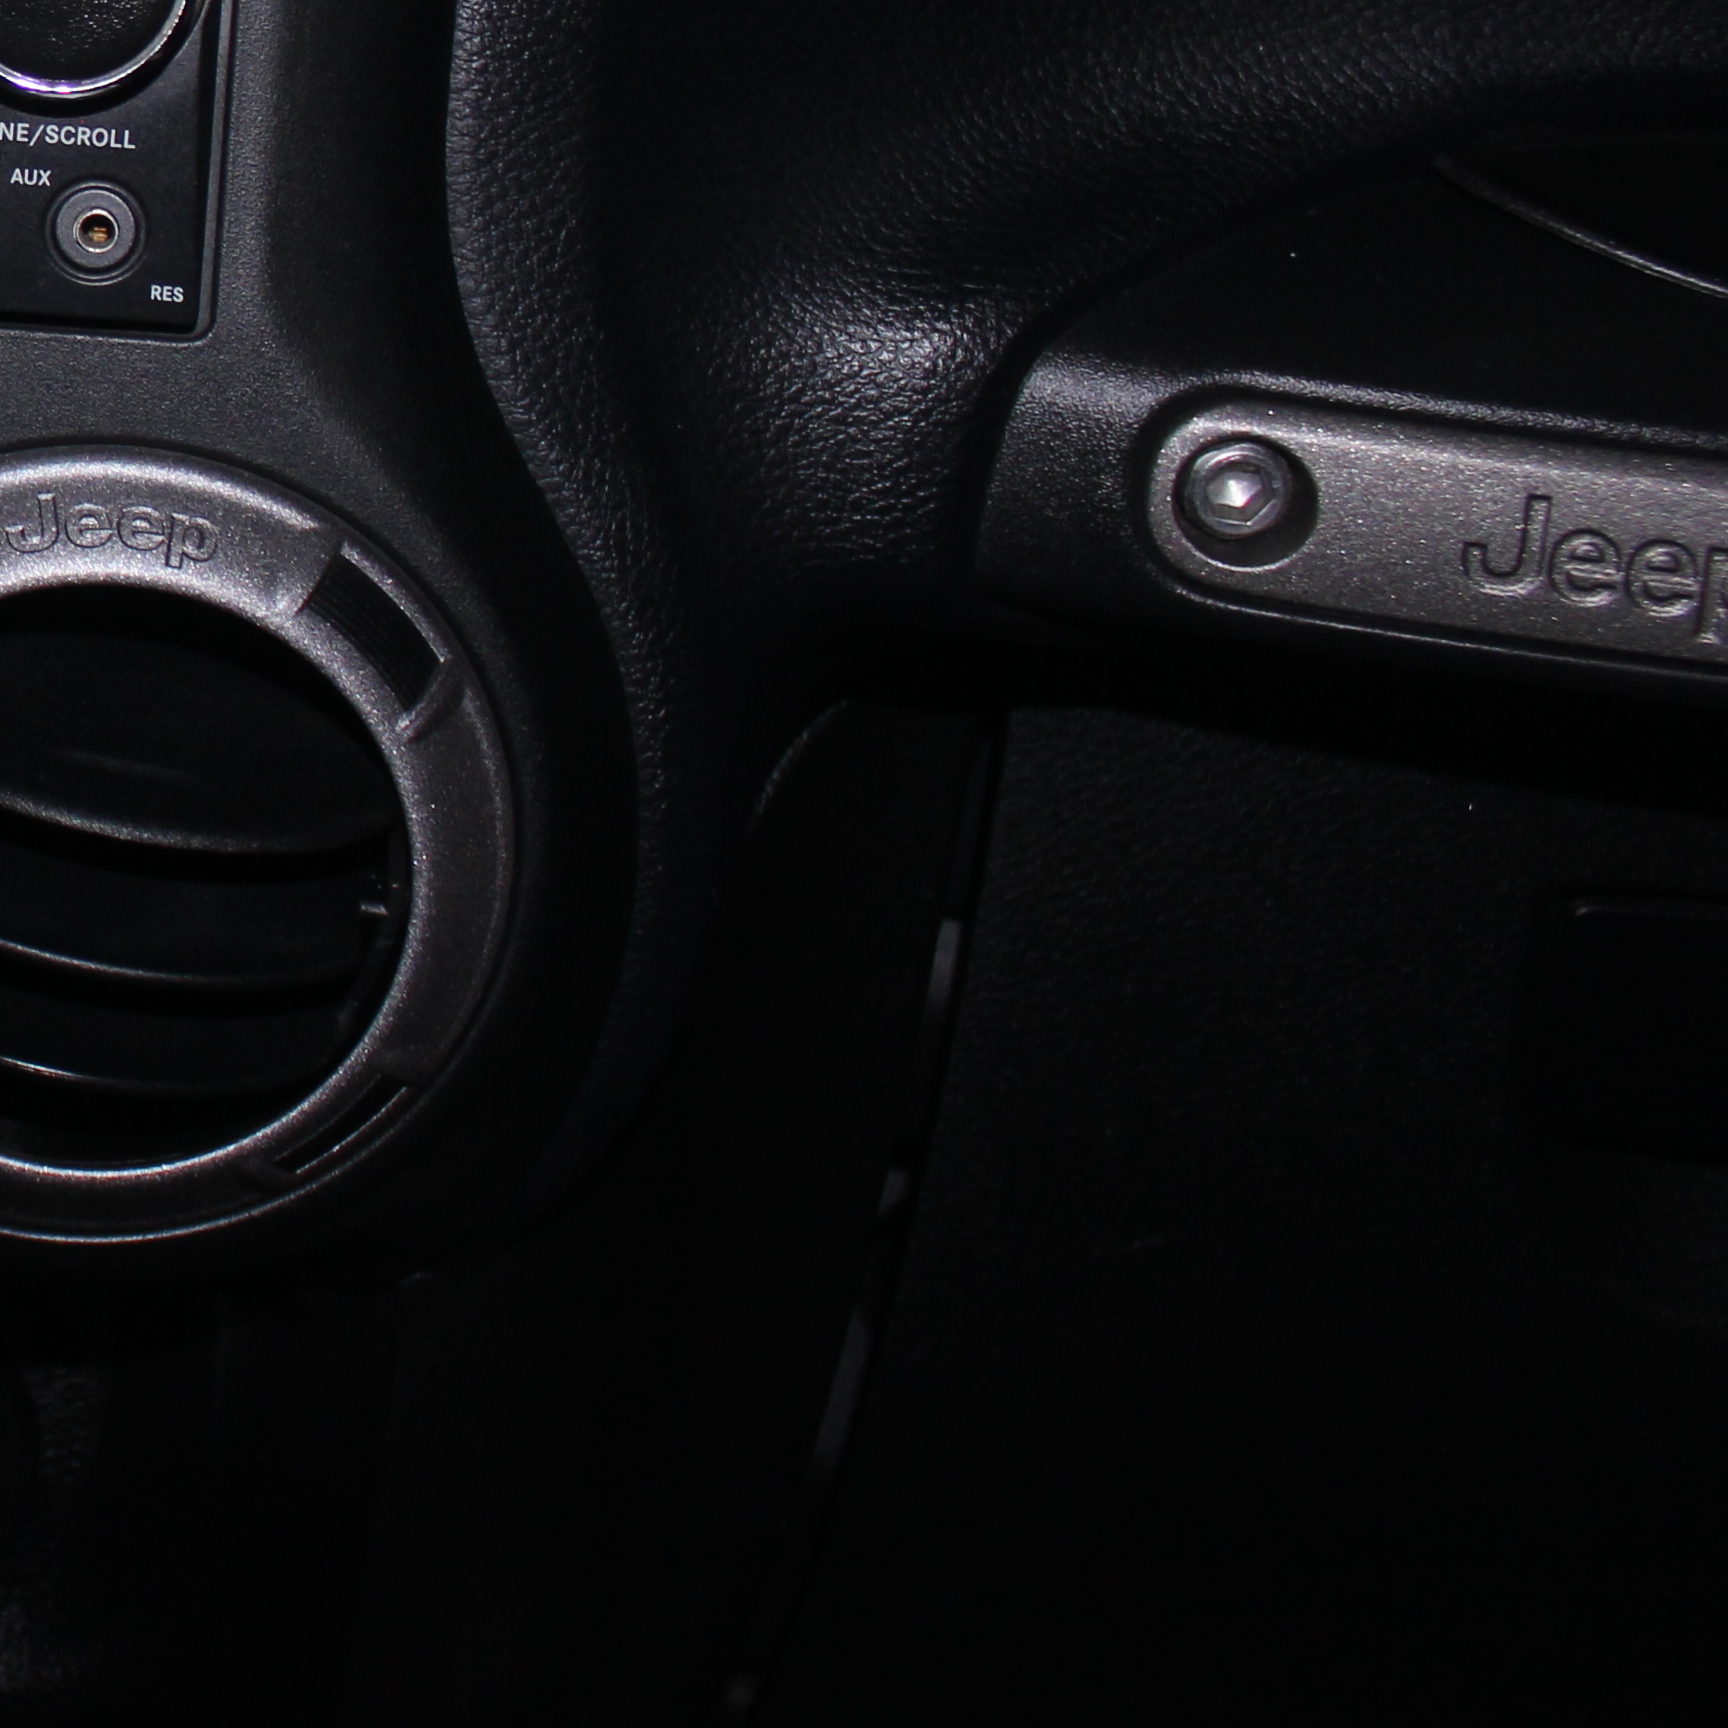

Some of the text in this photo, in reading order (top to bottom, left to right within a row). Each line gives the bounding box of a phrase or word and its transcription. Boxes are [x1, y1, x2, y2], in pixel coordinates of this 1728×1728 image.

[10, 167, 53, 188] AUX
[150, 284, 185, 304] RES
[3, 492, 221, 567] Jeep
